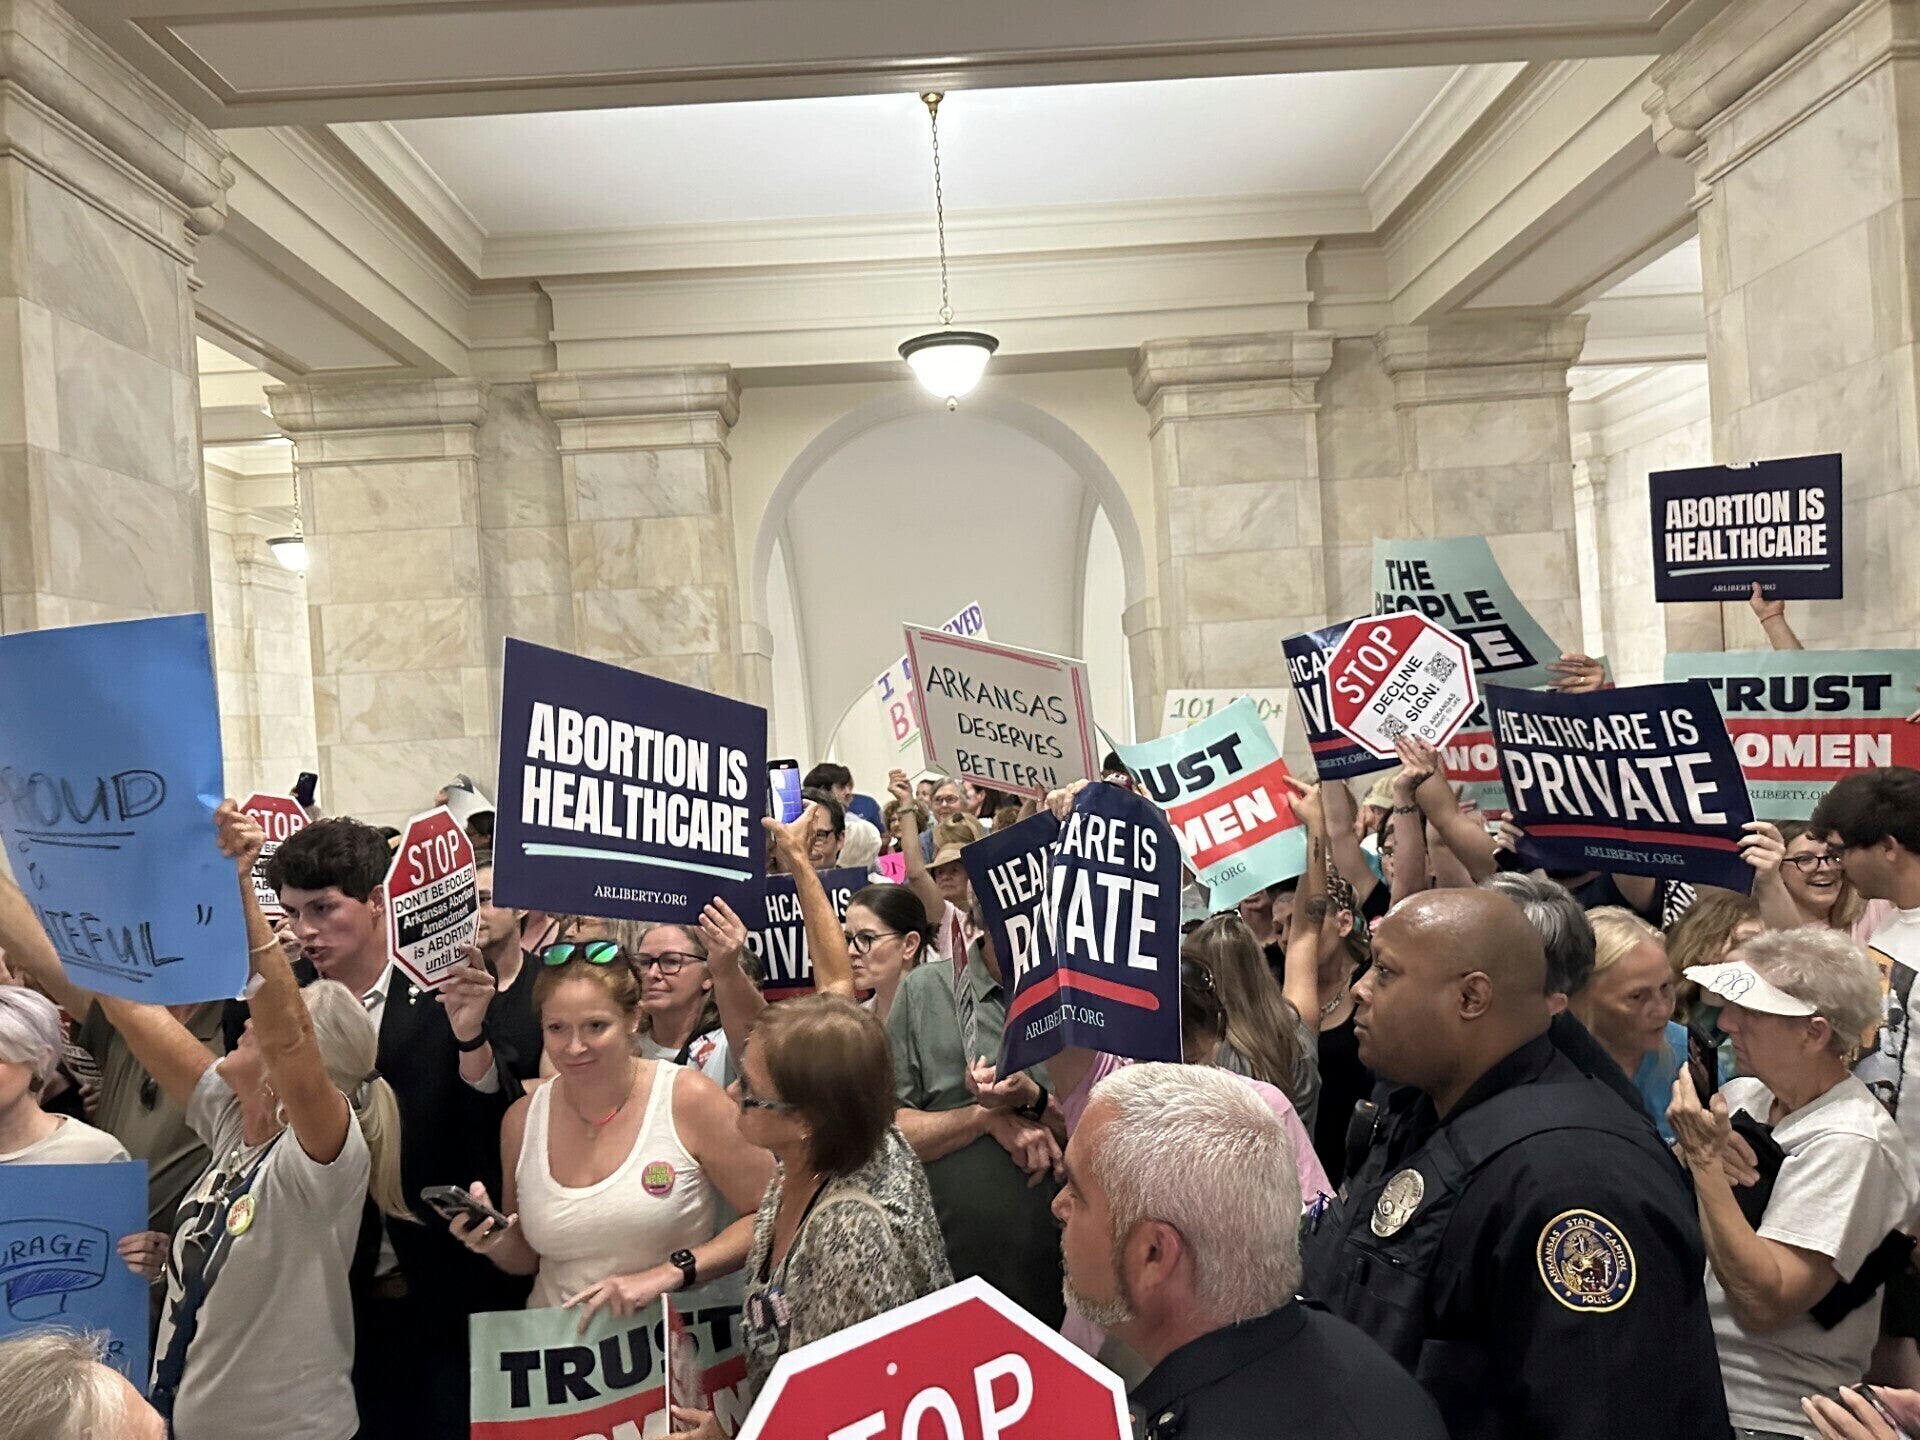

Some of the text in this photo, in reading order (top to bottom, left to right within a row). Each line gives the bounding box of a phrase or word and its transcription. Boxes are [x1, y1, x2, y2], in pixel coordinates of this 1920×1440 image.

[1665, 487, 1825, 530] ABORTION IS
[1664, 523, 1828, 562] HEALTHCARE
[1385, 559, 1435, 590] THE
[1336, 625, 1399, 704] STOP
[1373, 656, 1423, 715] DECLINE
[878, 672, 894, 701] I
[926, 665, 1068, 724] ARKANSAS
[1398, 685, 1419, 703] TO
[1405, 683, 1440, 722] SIGN!
[526, 701, 748, 800] ABORTION IS
[958, 713, 1063, 759] DESERVES
[1497, 708, 1657, 751] HEALTHCARE
[1660, 708, 1700, 748] IS
[1730, 733, 1892, 768] OMEN
[956, 749, 1058, 789] BETTER!!
[1139, 732, 1243, 803] UST
[1503, 750, 1728, 825] PRIVATE
[0, 766, 167, 826] ROUD
[521, 764, 749, 858] HEALTHCARE
[1749, 789, 1827, 800] RLIBERTY.O
[1171, 796, 1278, 857] MEN
[407, 829, 460, 886] STOP
[1133, 824, 1158, 873] IS
[1584, 846, 1685, 866] ARLIBERTY.ORG
[395, 867, 474, 915] DON'T BE FOOLED!
[403, 886, 475, 930] Arkansas Abortion
[594, 885, 688, 906] ARLIBERTY.ORG
[414, 945, 425, 960] is
[428, 919, 474, 955] ABORTION
[421, 904, 469, 937] Amendment
[425, 949, 452, 971] until
[0, 1234, 97, 1267] RAGE
[1545, 1218, 1627, 1284] ARKANSAS STATE CAPITOL
[1582, 1294, 1613, 1304] POLICE
